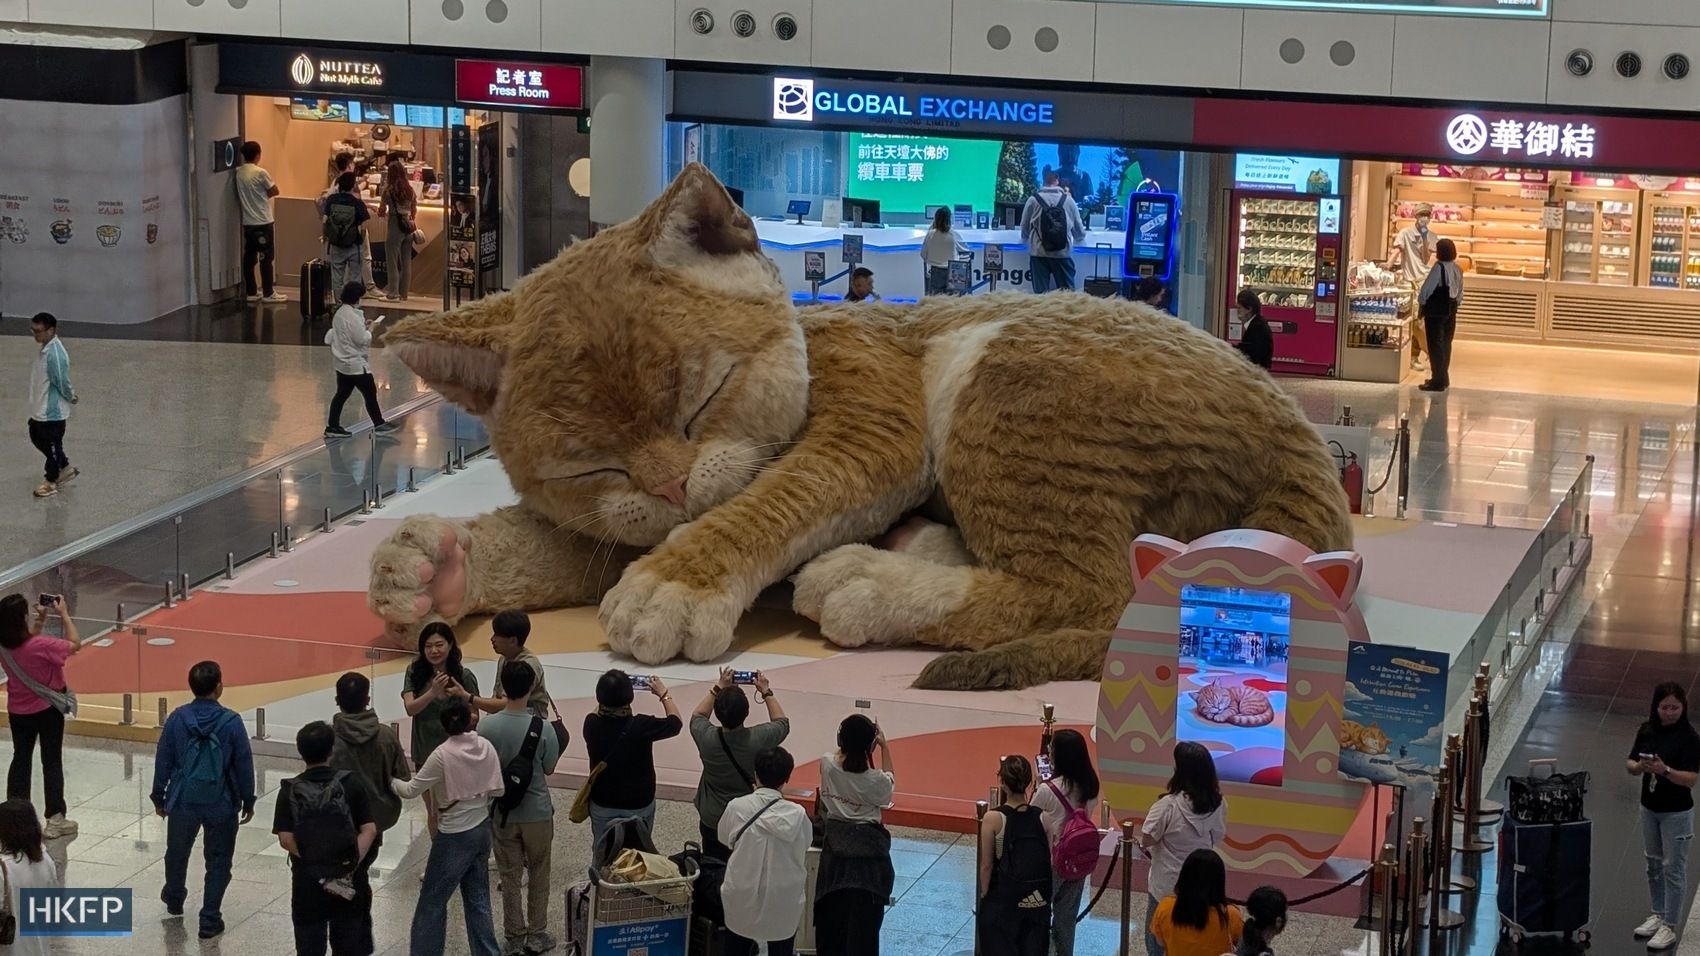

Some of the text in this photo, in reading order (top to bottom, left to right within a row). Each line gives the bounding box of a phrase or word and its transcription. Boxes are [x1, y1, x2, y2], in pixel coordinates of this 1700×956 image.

[320, 60, 382, 75] NUTTEA
[320, 74, 337, 82] Nut
[338, 75, 360, 85] Mylk
[495, 67, 543, 86] 記者室
[489, 84, 549, 99] Press Room
[814, 91, 1054, 124] GLOBAL EXCHANGE
[926, 118, 961, 128] LIMITED
[1490, 119, 1596, 158] 華御結
[858, 144, 949, 160] 前往天壇大佛的
[857, 162, 925, 181] 纜車車票
